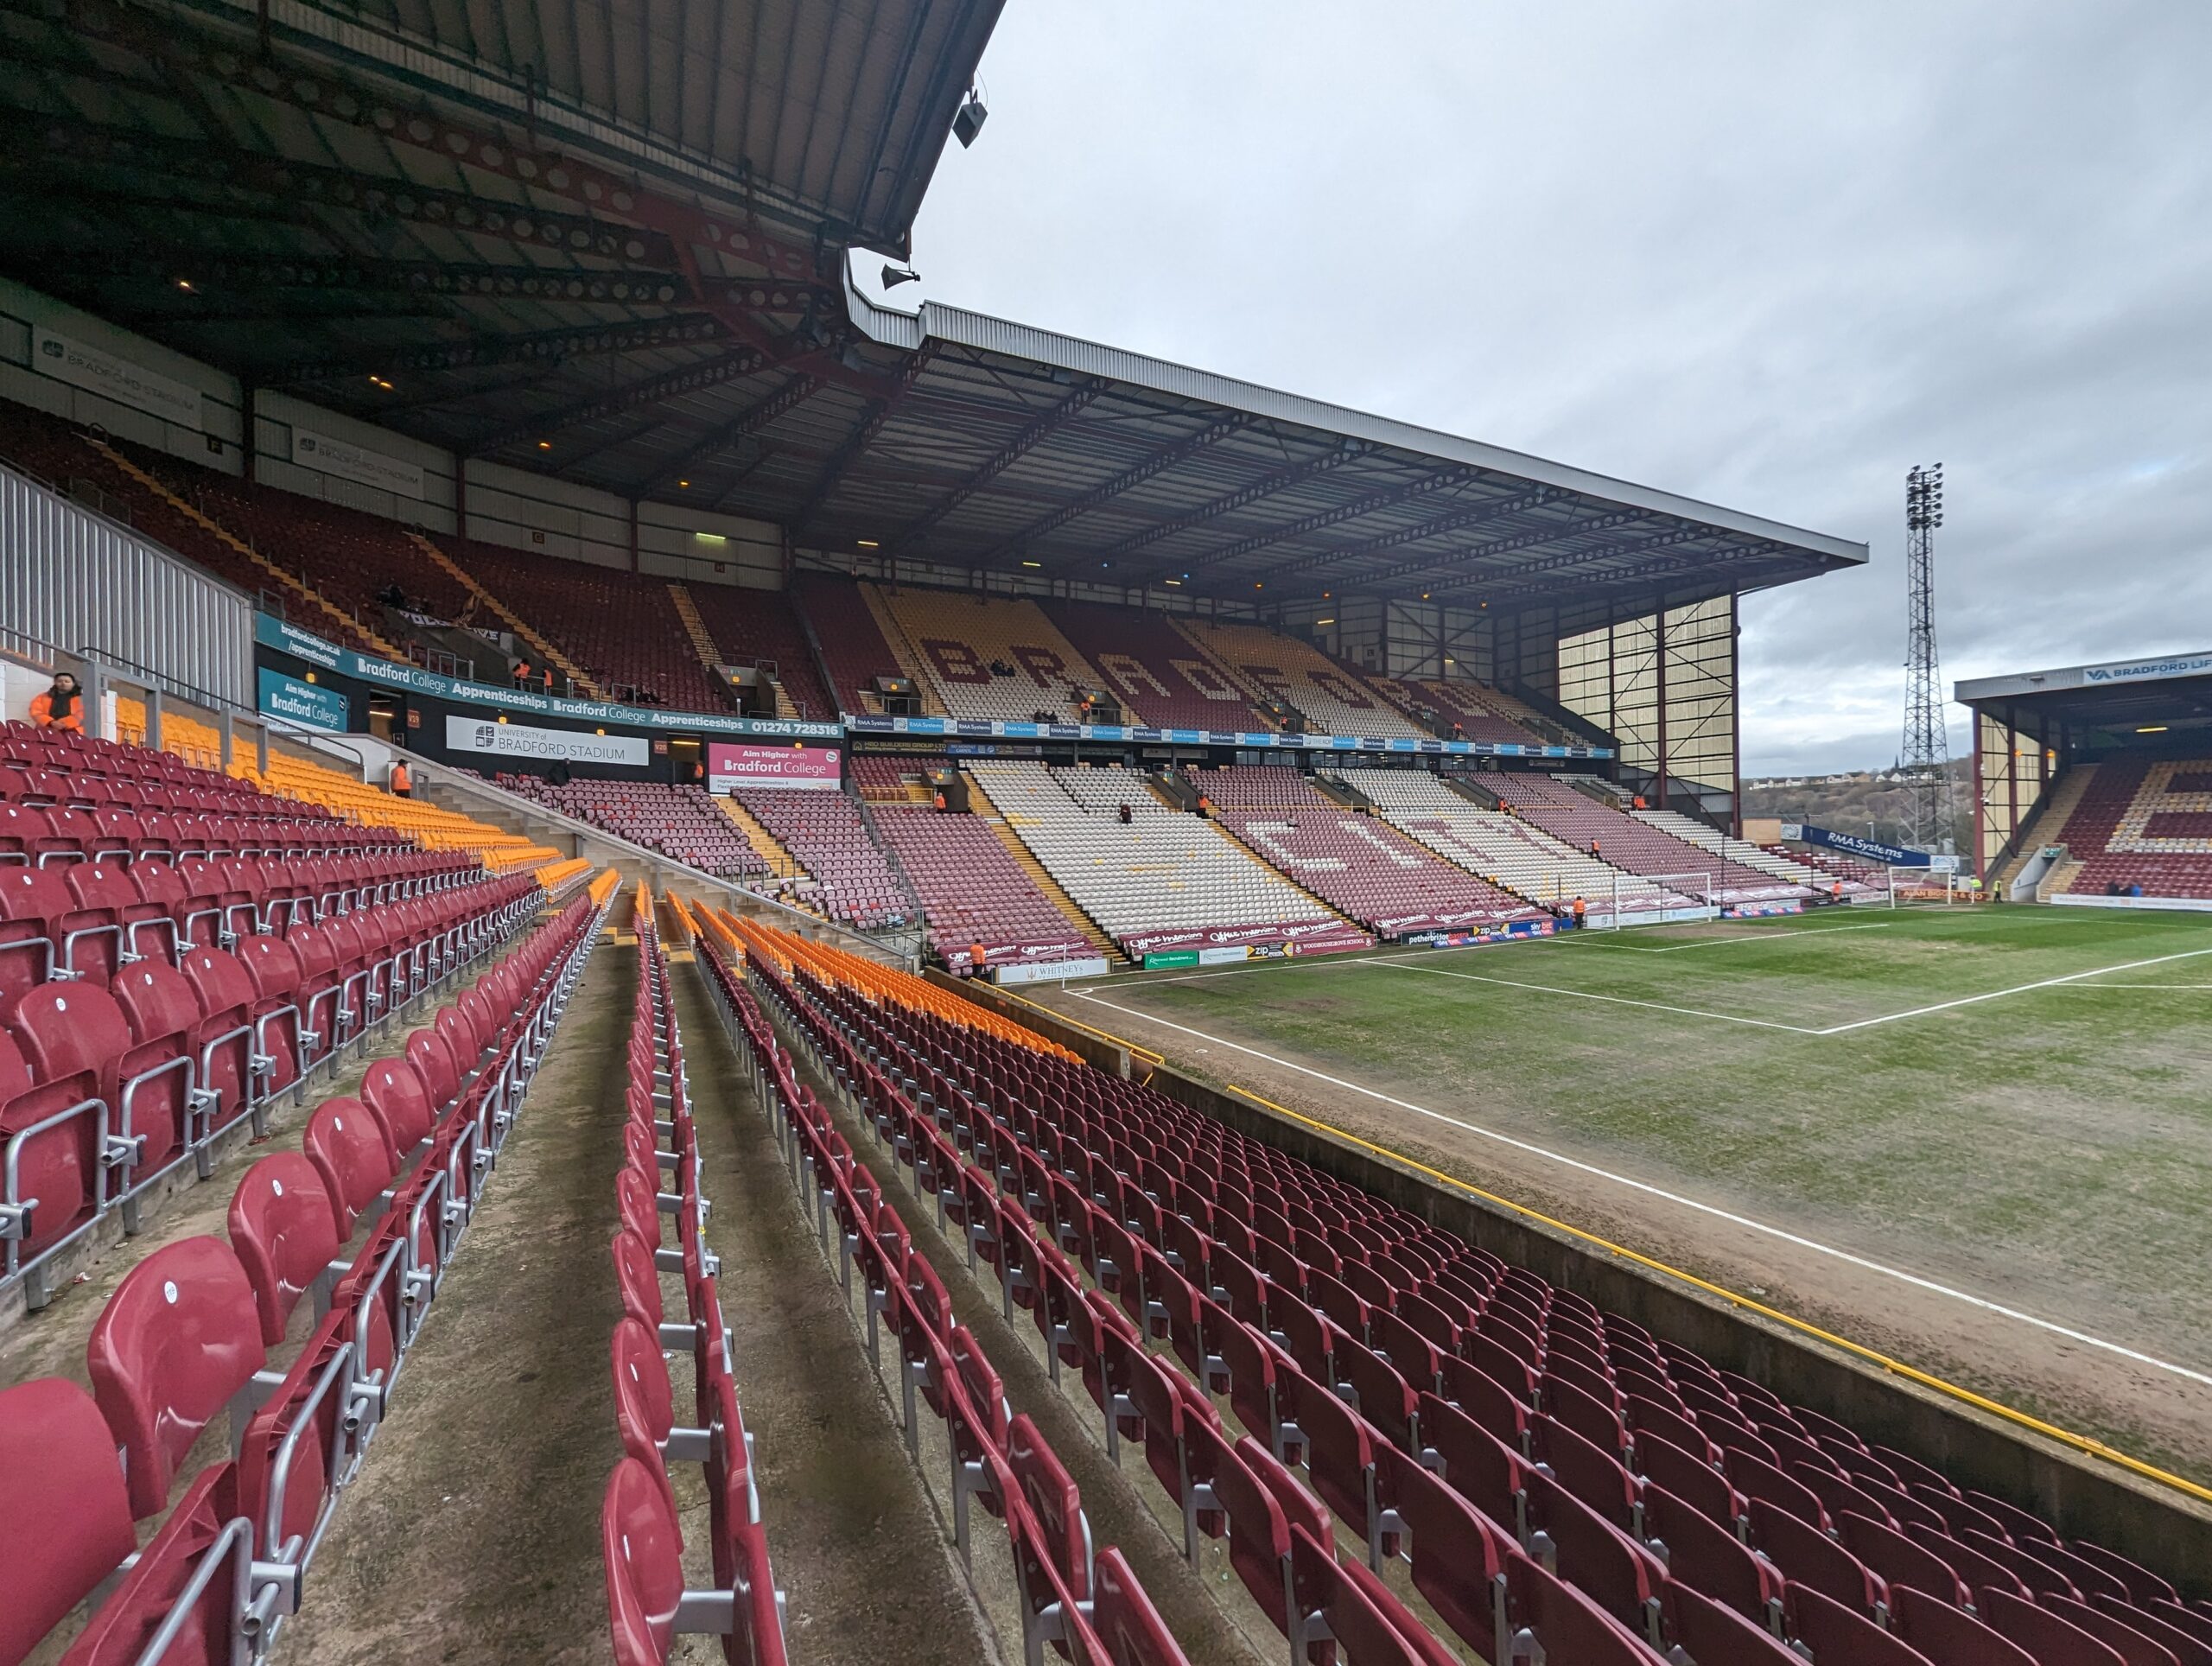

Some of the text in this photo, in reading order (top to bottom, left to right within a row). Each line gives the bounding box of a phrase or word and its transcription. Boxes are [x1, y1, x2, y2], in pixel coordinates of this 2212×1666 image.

[281, 623, 340, 657] bradfordcollege.ac.uk
[288, 639, 336, 666] /apprenticeships
[2113, 663, 2188, 677] BRADFORD
[284, 683, 297, 694] Aim
[297, 686, 316, 699] Higher
[358, 658, 838, 735] Bradford College Apprenticeships Bradford College Apprenticeships 01274 728316
[271, 693, 338, 727] Bradford College
[499, 728, 540, 740] UNIVERSITY
[499, 737, 625, 760] BRADFORD STADIUM
[761, 751, 790, 760] Higher
[724, 760, 826, 776] Bradford College
[1827, 832, 1904, 859] RMA Systems
[1255, 946, 1268, 956] zip
